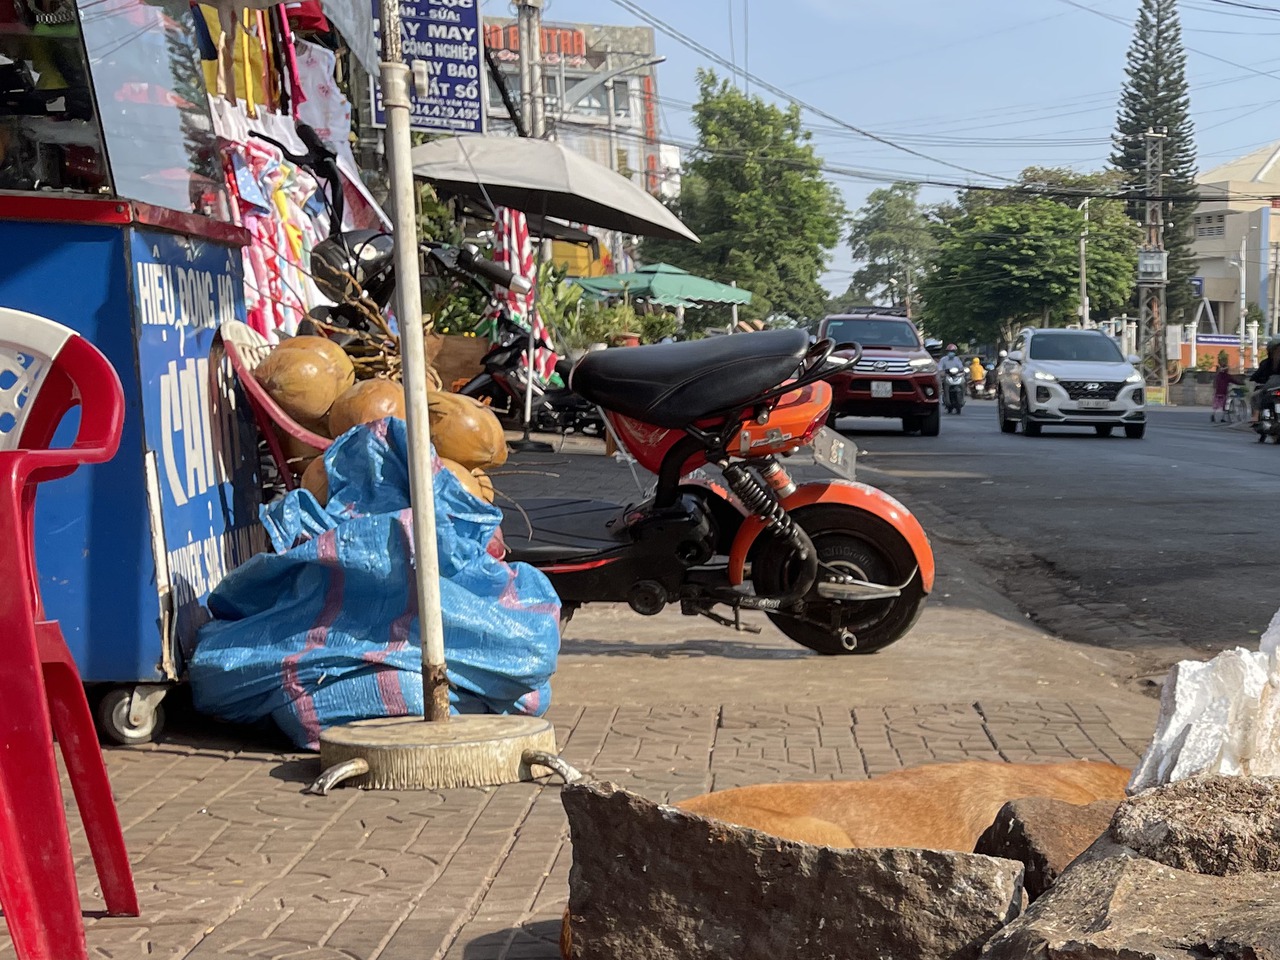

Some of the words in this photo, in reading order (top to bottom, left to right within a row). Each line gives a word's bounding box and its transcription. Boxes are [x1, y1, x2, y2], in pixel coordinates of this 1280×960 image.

[428, 24, 475, 41] MAY
[402, 37, 433, 57] CÔNG
[435, 42, 477, 62] NGHIỆP
[447, 63, 477, 79] BAO
[137, 244, 175, 341] HIỆU
